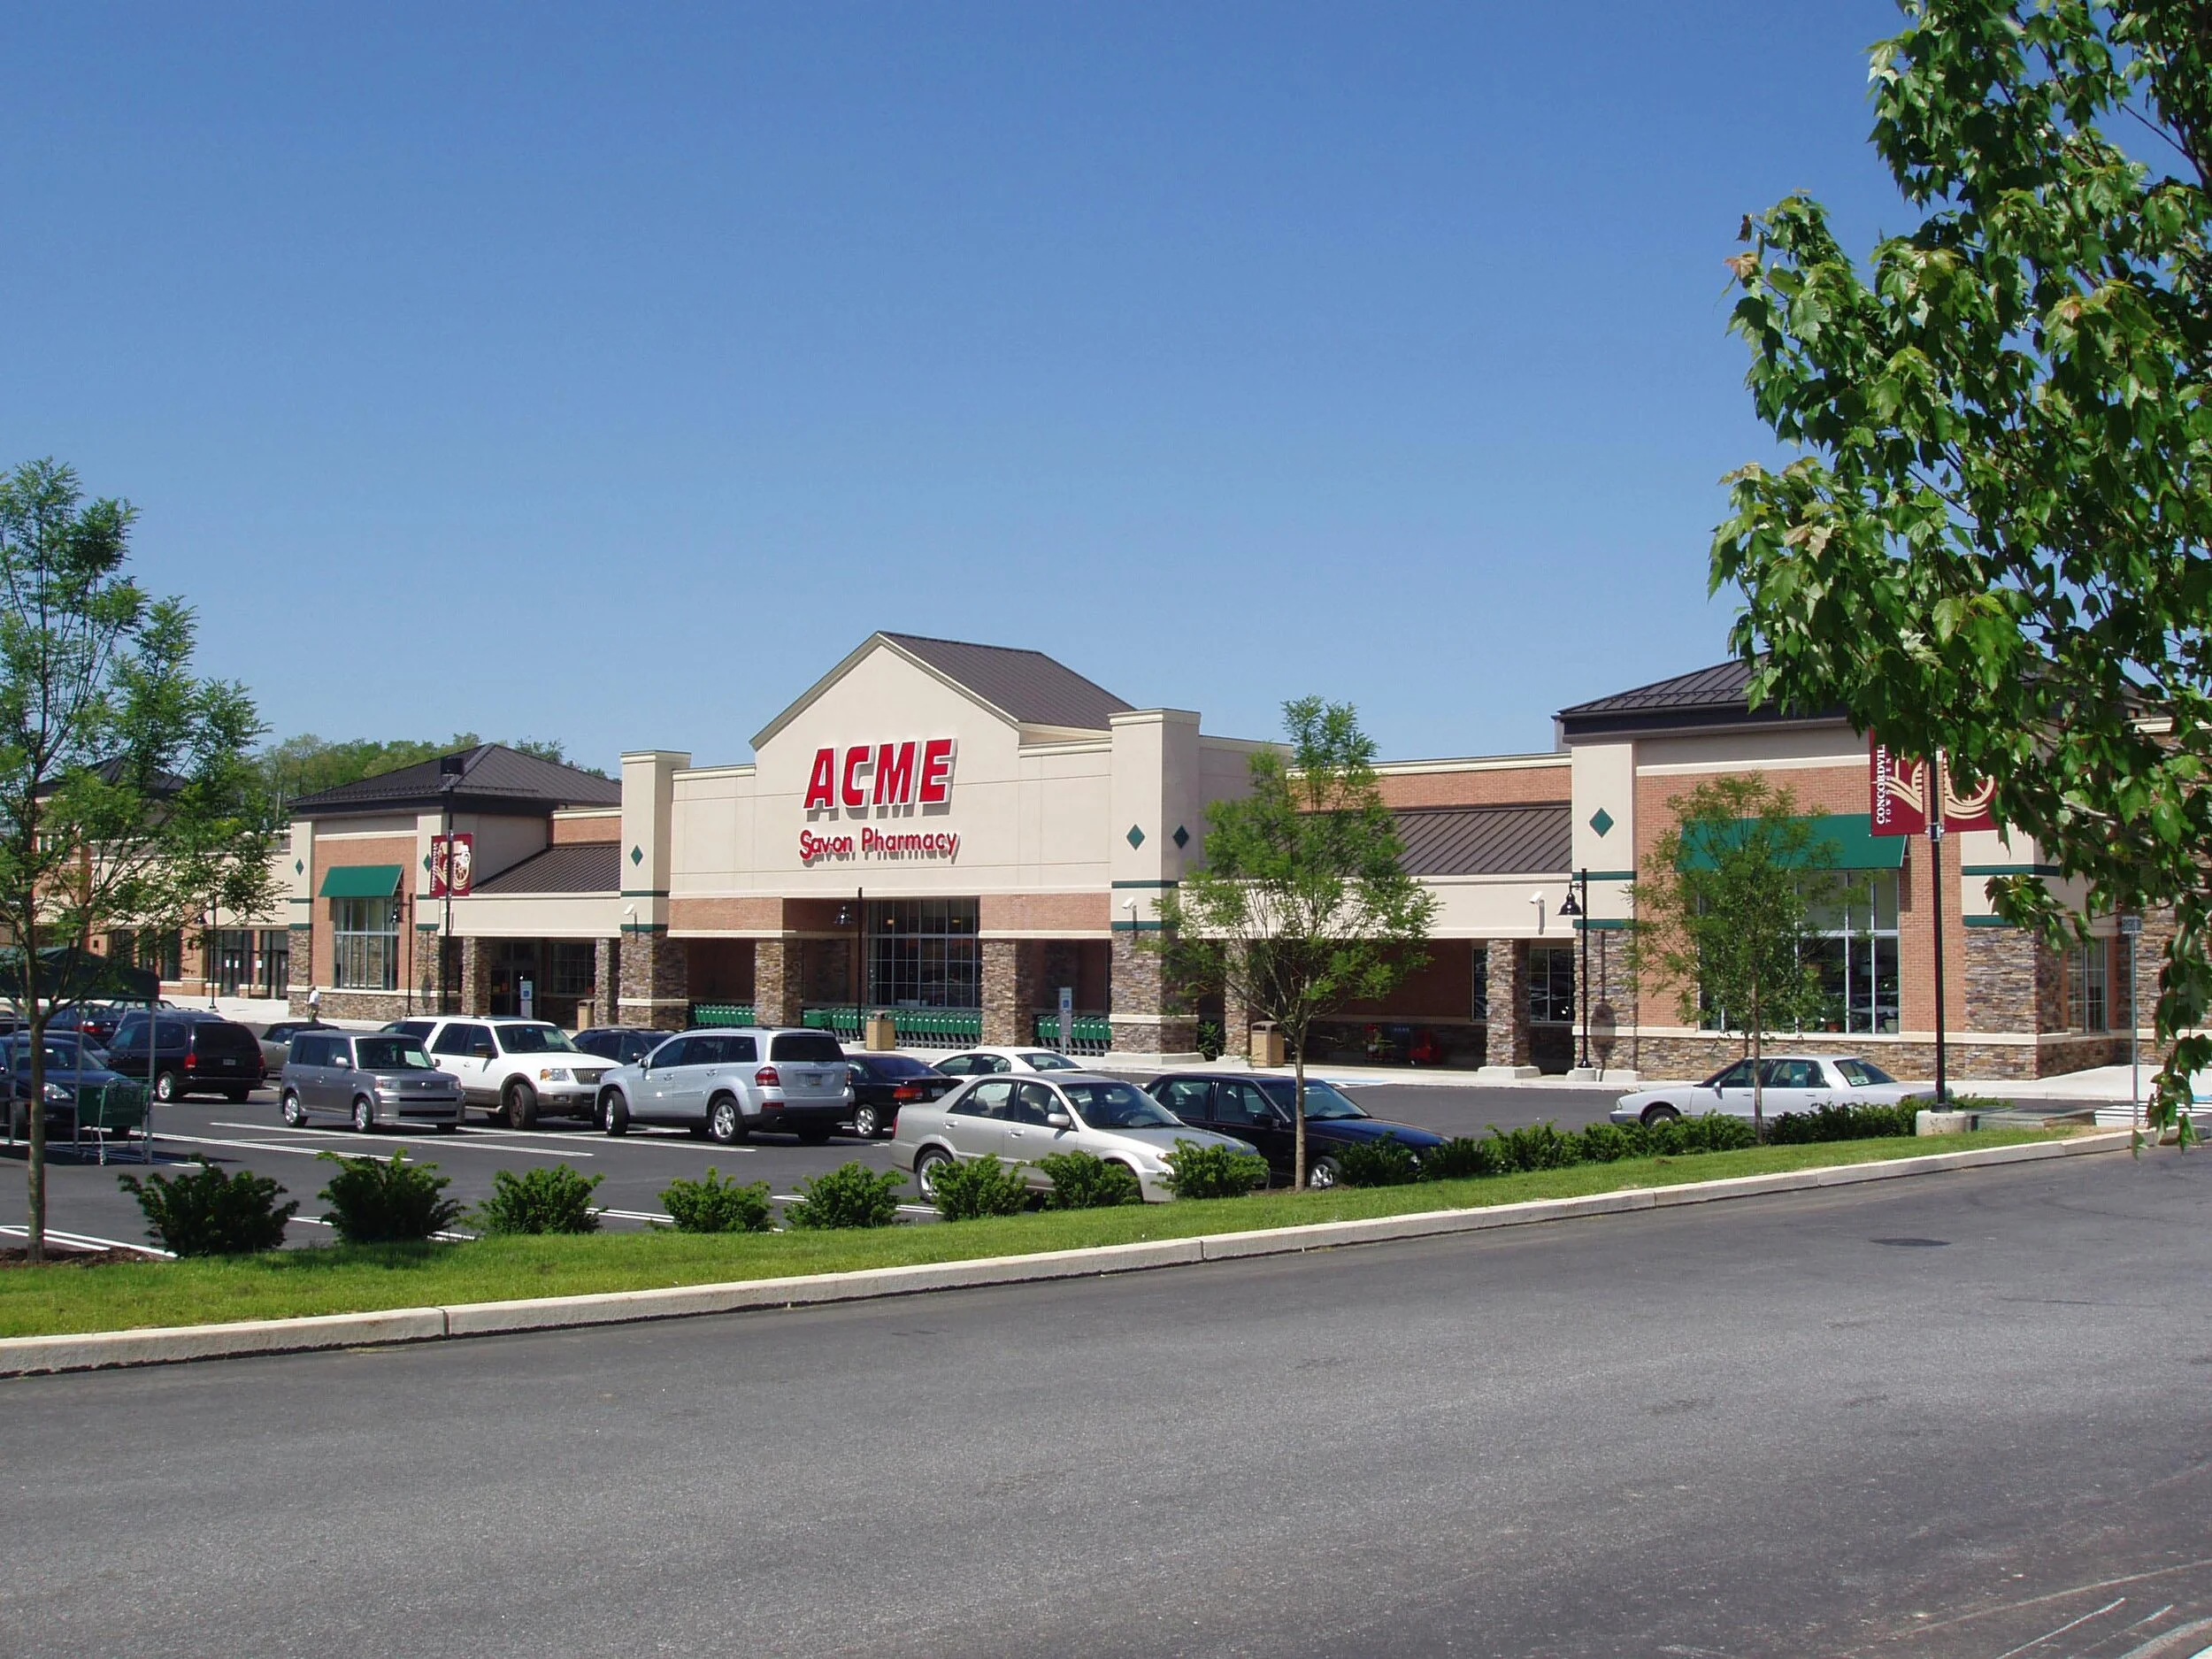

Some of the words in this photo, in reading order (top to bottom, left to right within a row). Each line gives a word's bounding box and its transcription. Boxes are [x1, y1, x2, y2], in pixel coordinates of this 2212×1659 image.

[803, 738, 954, 809] ACME
[1877, 744, 1886, 826] CONCORDVIL
[862, 827, 957, 856] Pharmacy
